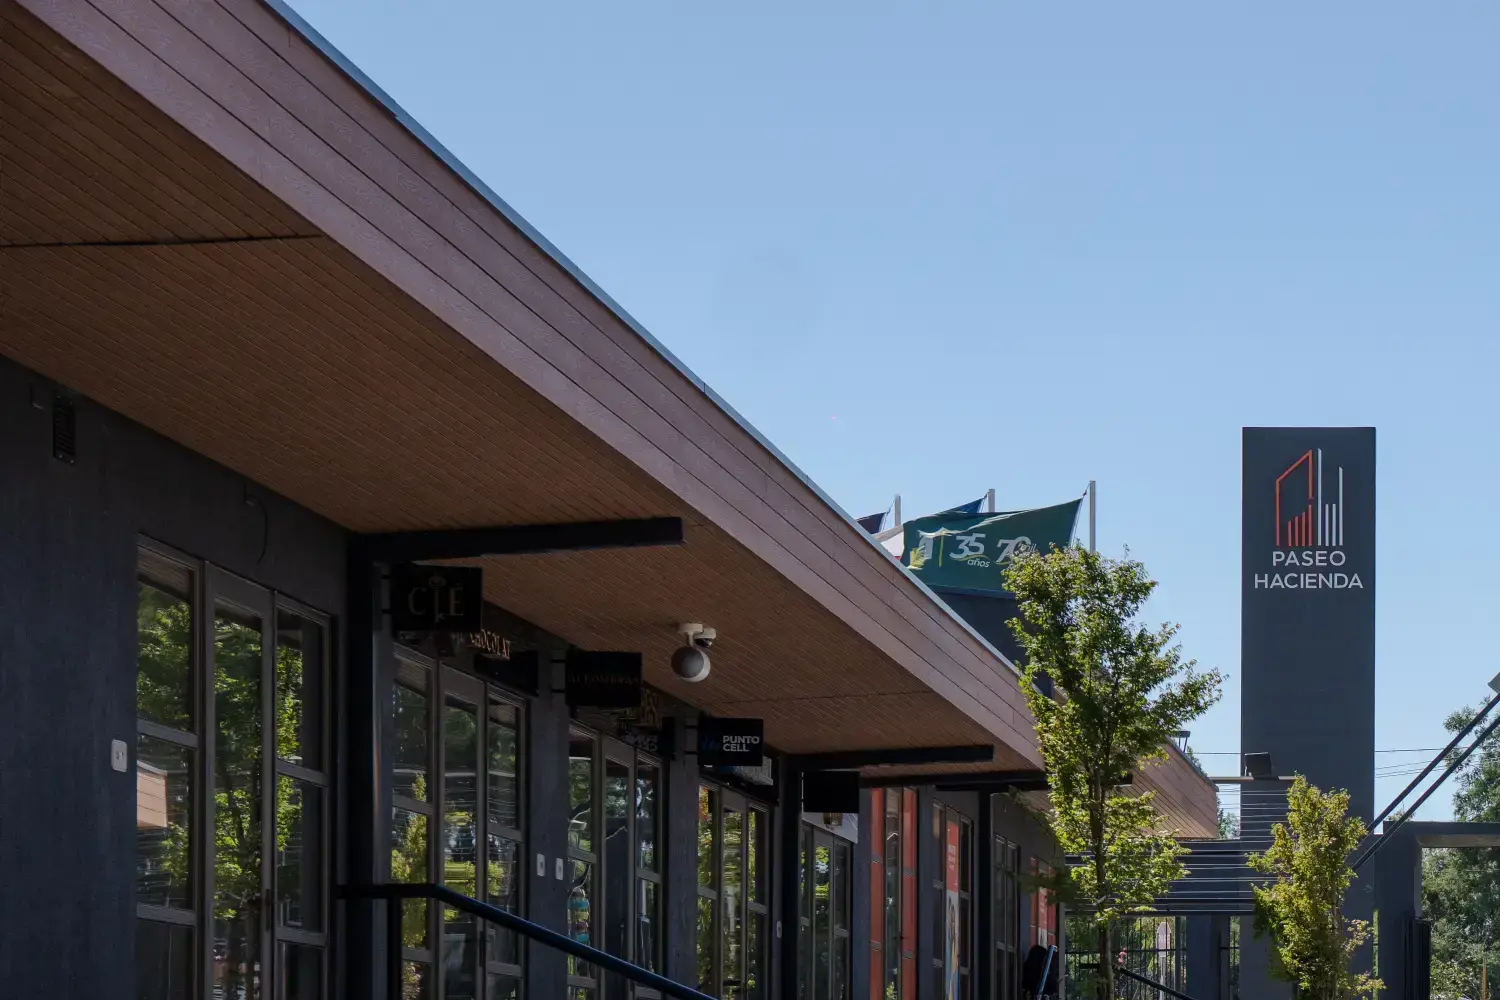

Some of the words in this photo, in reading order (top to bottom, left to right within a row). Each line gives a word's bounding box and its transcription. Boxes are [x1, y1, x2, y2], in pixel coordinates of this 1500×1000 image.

[949, 532, 986, 559] 35
[967, 558, 991, 568] años
[1272, 550, 1346, 566] PASEO
[1254, 573, 1364, 589] HACIENDA
[722, 735, 760, 745] PUNTO
[722, 744, 750, 752] CELL
